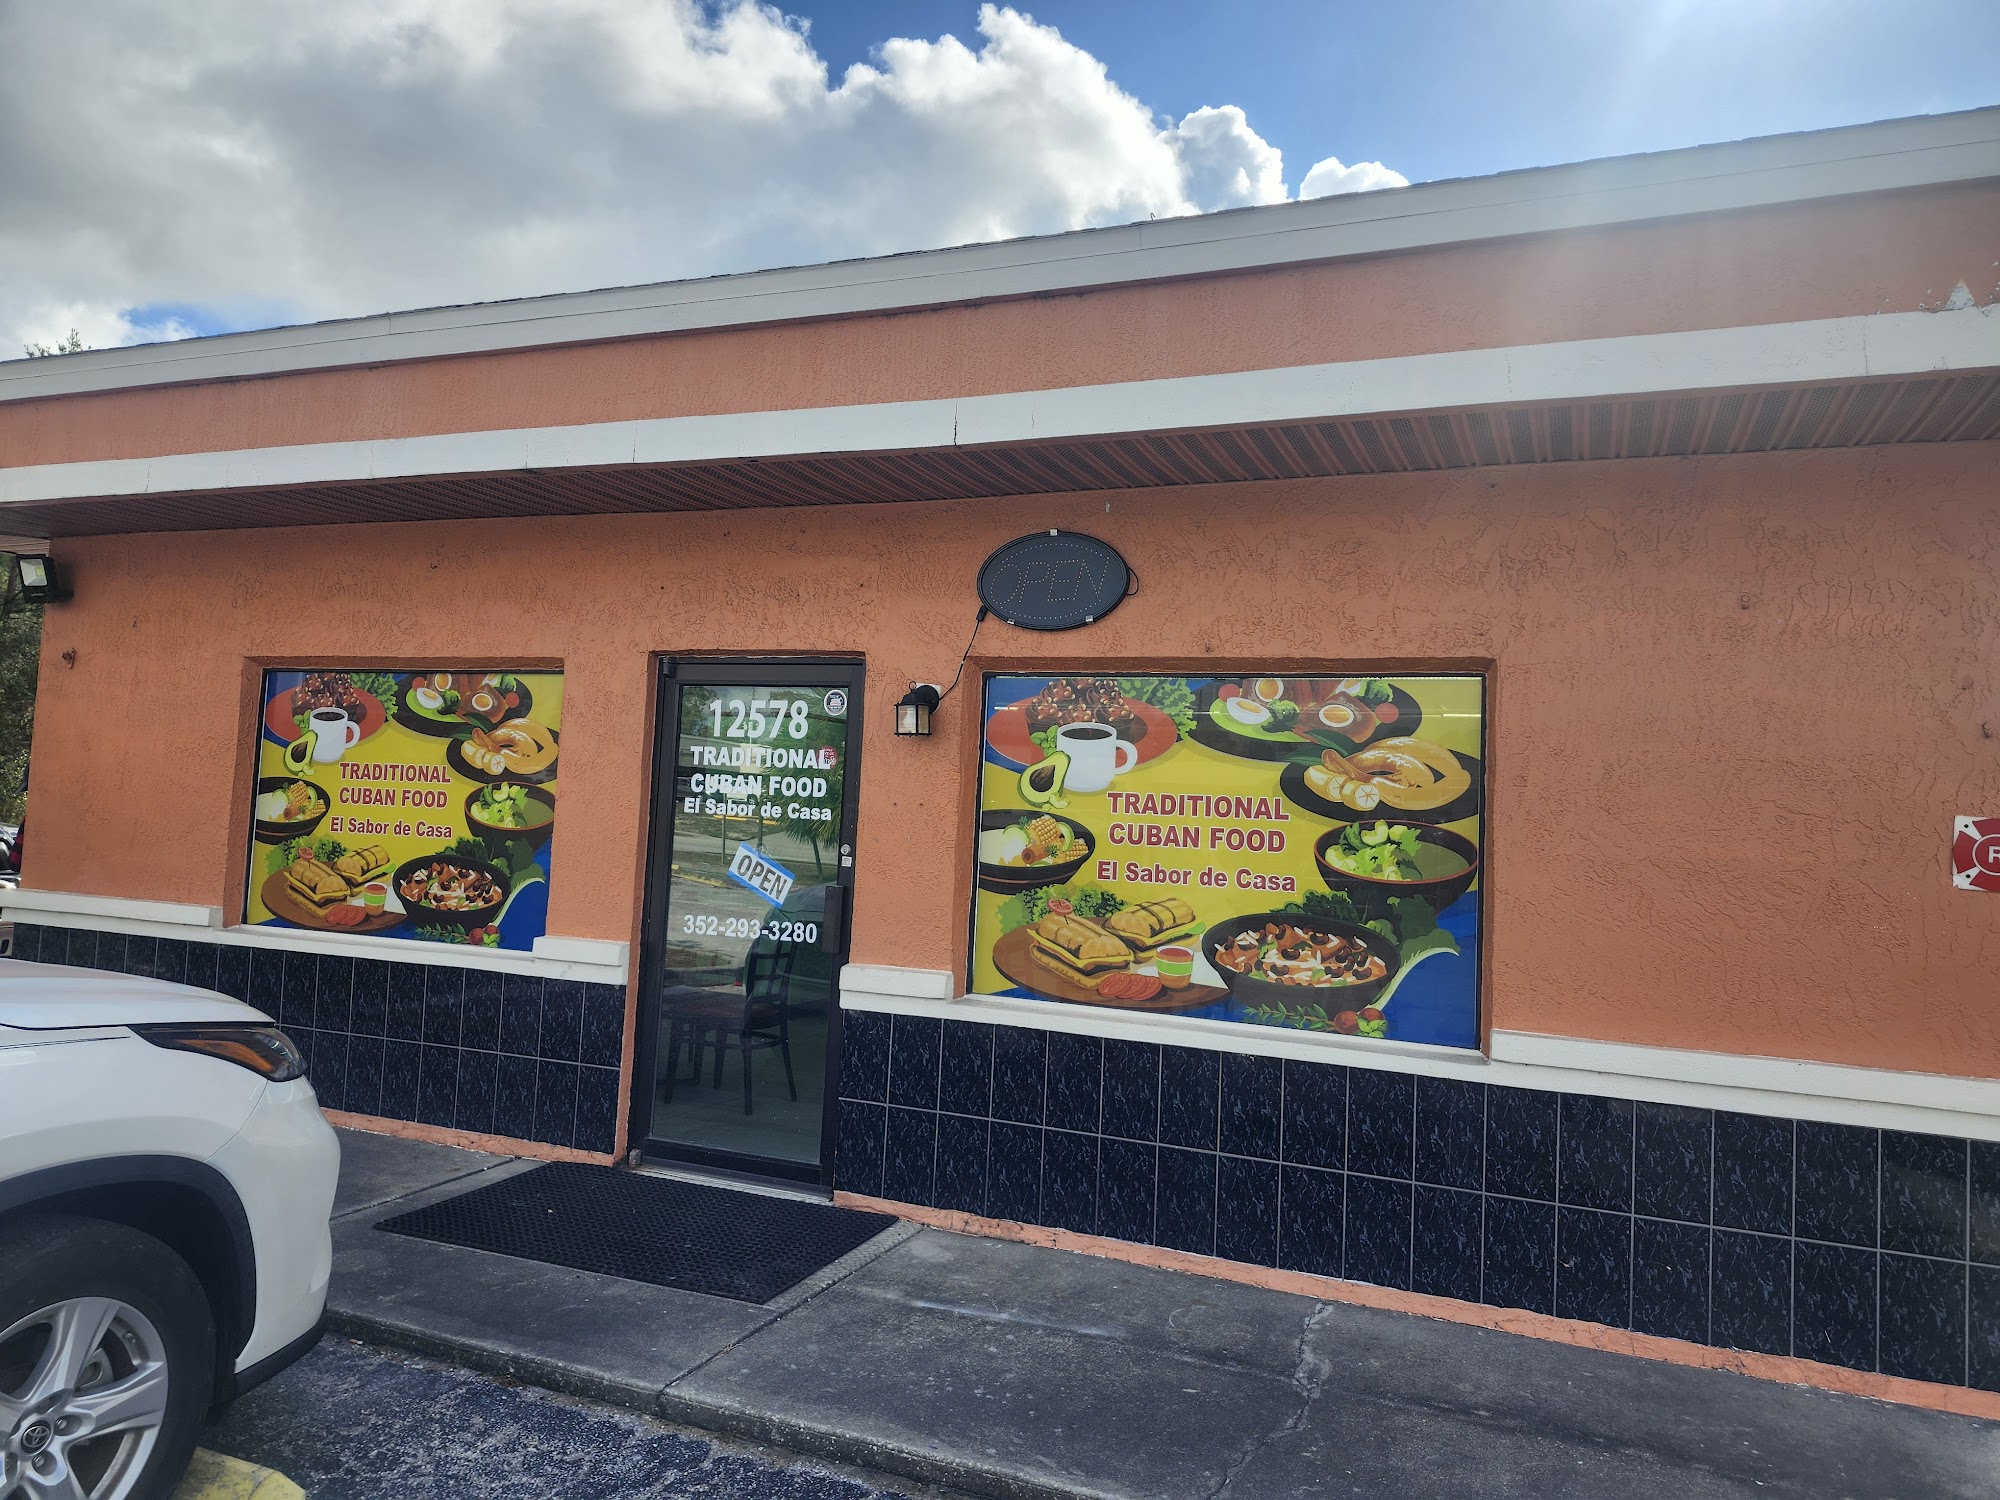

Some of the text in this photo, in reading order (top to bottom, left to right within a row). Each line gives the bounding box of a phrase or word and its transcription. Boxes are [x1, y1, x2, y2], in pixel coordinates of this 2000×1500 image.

[990, 556, 1110, 604] OPEN
[710, 699, 808, 739] 12578
[690, 746, 831, 769] TRADITIONAL
[340, 763, 451, 783] TRADITIONAL
[690, 773, 827, 798] CUBAN FOOD
[339, 787, 448, 808] CUBAN FOOD
[684, 798, 832, 821] El Sabor de Casa
[1107, 792, 1289, 820] TRADITIONAL
[330, 817, 452, 838] El Sabor de Casa
[1109, 823, 1286, 853] CUBAN FOOD
[736, 854, 788, 901] OPEN
[1097, 860, 1296, 892] El Sabor de Casa
[683, 914, 818, 944] 352-293-3280
